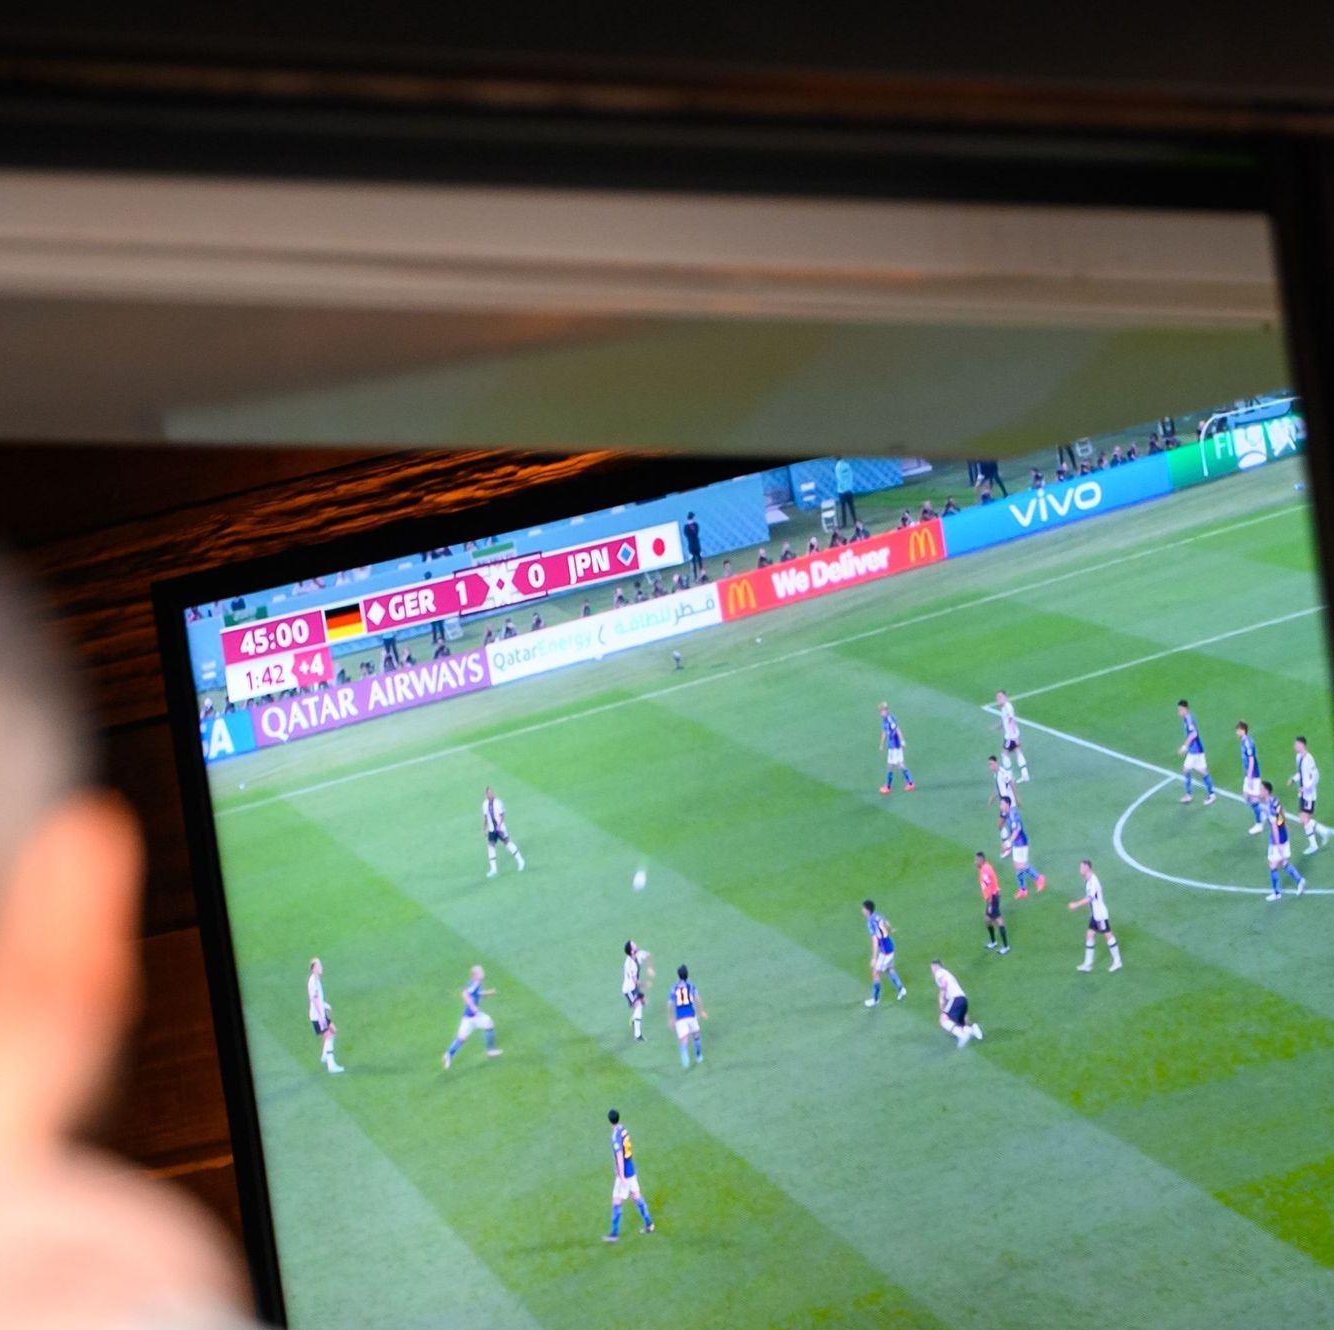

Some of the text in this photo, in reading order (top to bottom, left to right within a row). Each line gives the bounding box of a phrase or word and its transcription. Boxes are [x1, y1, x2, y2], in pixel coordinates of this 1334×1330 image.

[1009, 481, 1102, 528] vivo
[388, 546, 611, 621] GER 1 0 JPN
[771, 568, 810, 598] We
[810, 547, 891, 589] Deliver
[240, 618, 310, 656] 45:00
[493, 630, 592, 670] QatarEnergy
[246, 653, 325, 691] 1:42 +4
[261, 652, 485, 743] QATAR AIRWAYS
